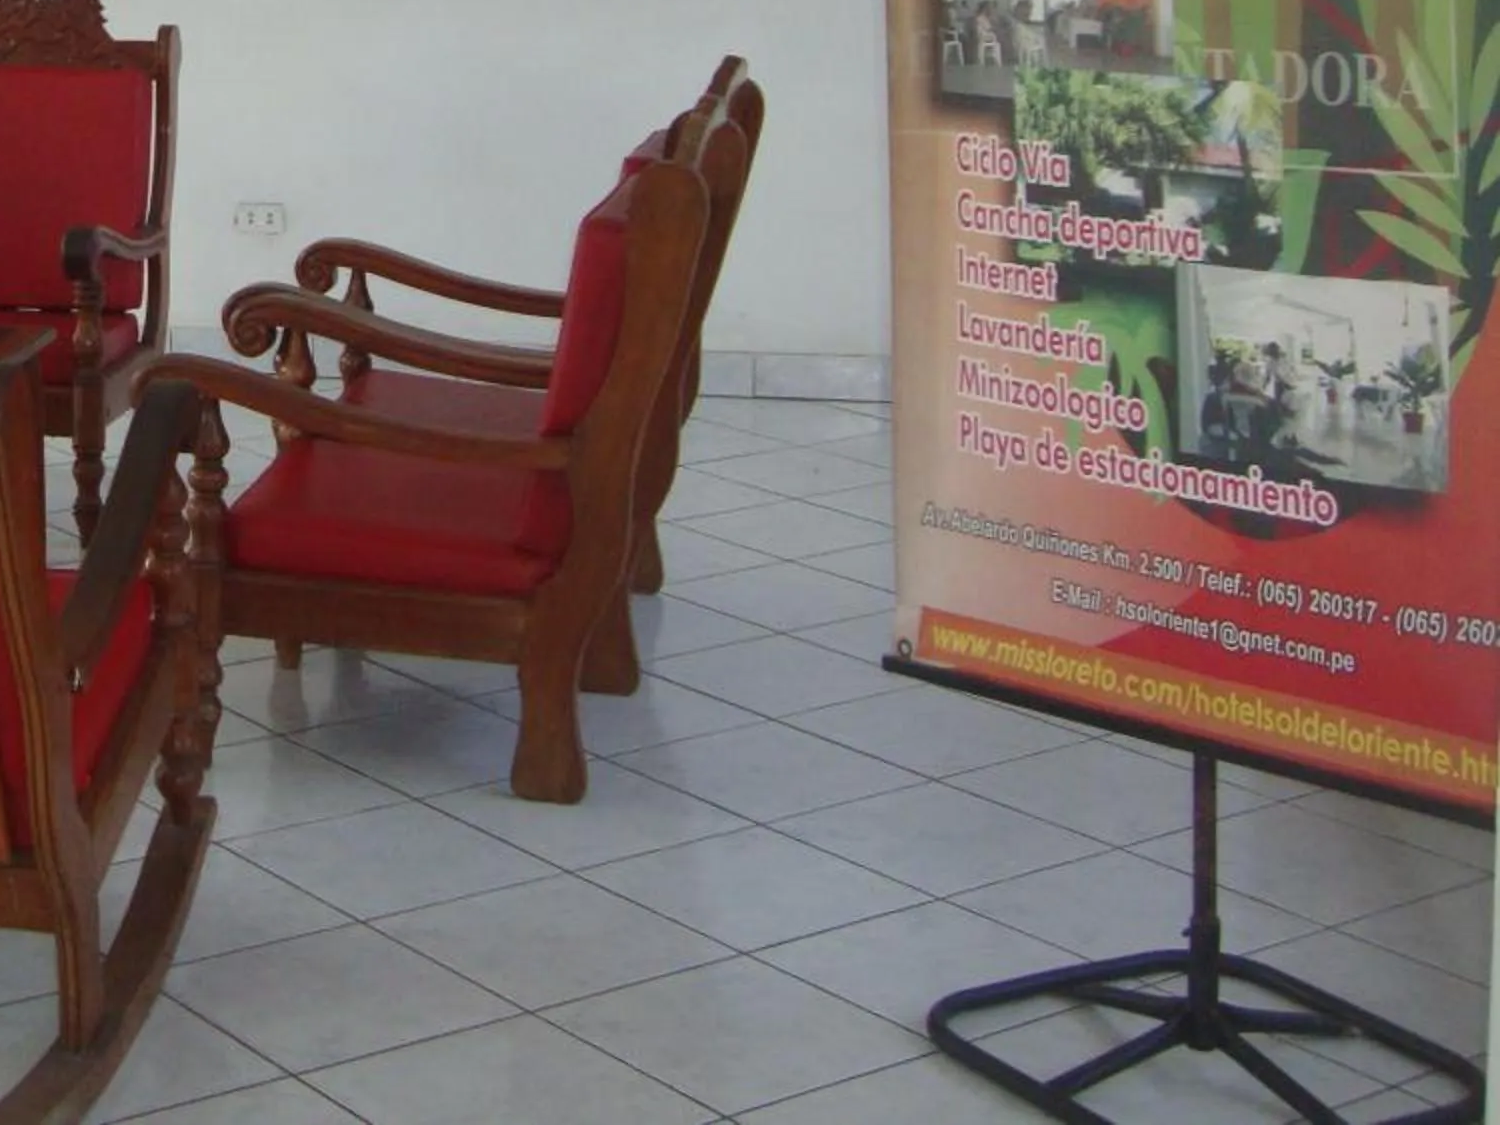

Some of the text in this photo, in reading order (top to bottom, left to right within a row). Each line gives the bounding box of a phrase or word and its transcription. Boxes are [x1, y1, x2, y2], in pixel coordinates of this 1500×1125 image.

[956, 134, 1070, 185] Ciclo Via
[956, 192, 1202, 260] Cancha deportiva
[957, 247, 1058, 300] Internet
[957, 305, 1104, 363] Lavandería
[957, 359, 1147, 431] Minizoologico
[958, 414, 1337, 525] Playa de estacionamiento
[1022, 525, 1099, 562] Quiñones
[1139, 553, 1183, 583] 2.500
[1256, 577, 1304, 614] (065)
[1308, 588, 1379, 624] 260317
[1395, 606, 1449, 643] (065)
[1456, 616, 1500, 648] 260
[1051, 579, 1100, 611] E-Mail
